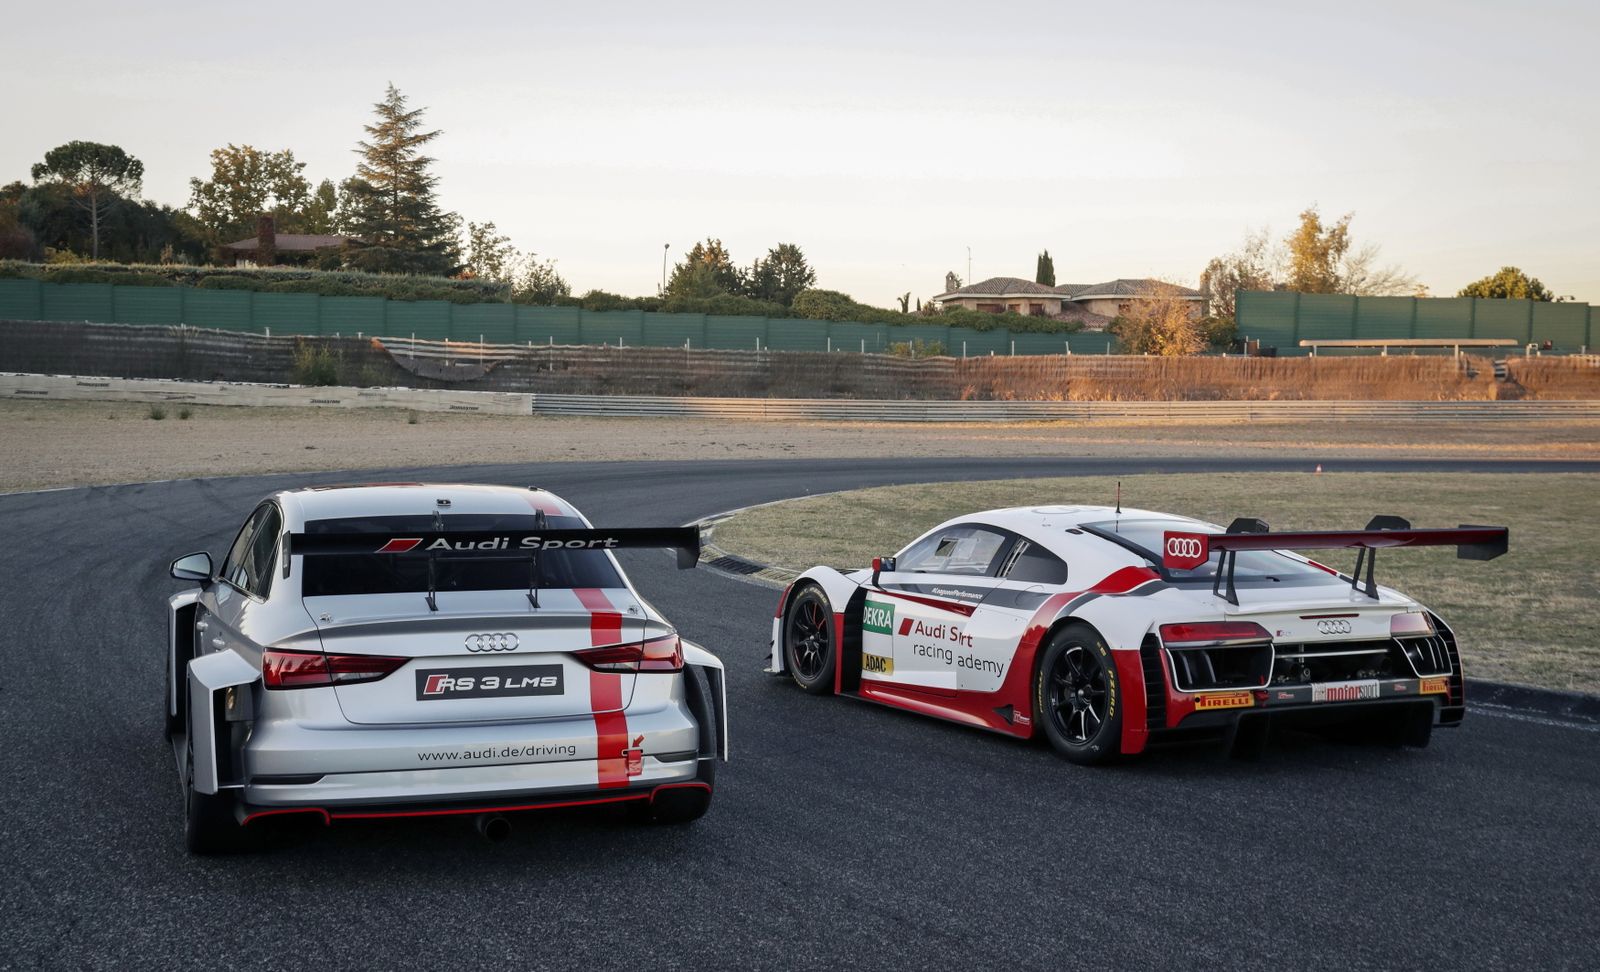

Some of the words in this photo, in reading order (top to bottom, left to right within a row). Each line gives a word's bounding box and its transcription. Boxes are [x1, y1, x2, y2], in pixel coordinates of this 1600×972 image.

[425, 537, 509, 551] Audi
[519, 536, 619, 551] Sport
[863, 605, 892, 629] DEKRA
[915, 620, 946, 639] Audi
[950, 626, 973, 648] Srt
[913, 643, 953, 665] racing
[865, 657, 887, 673] ADAC
[436, 677, 476, 692] RS
[480, 676, 500, 690] 3
[504, 676, 558, 689] LMS
[1200, 692, 1249, 707] PIRELLI
[417, 744, 577, 761] www.audi.de/driving
